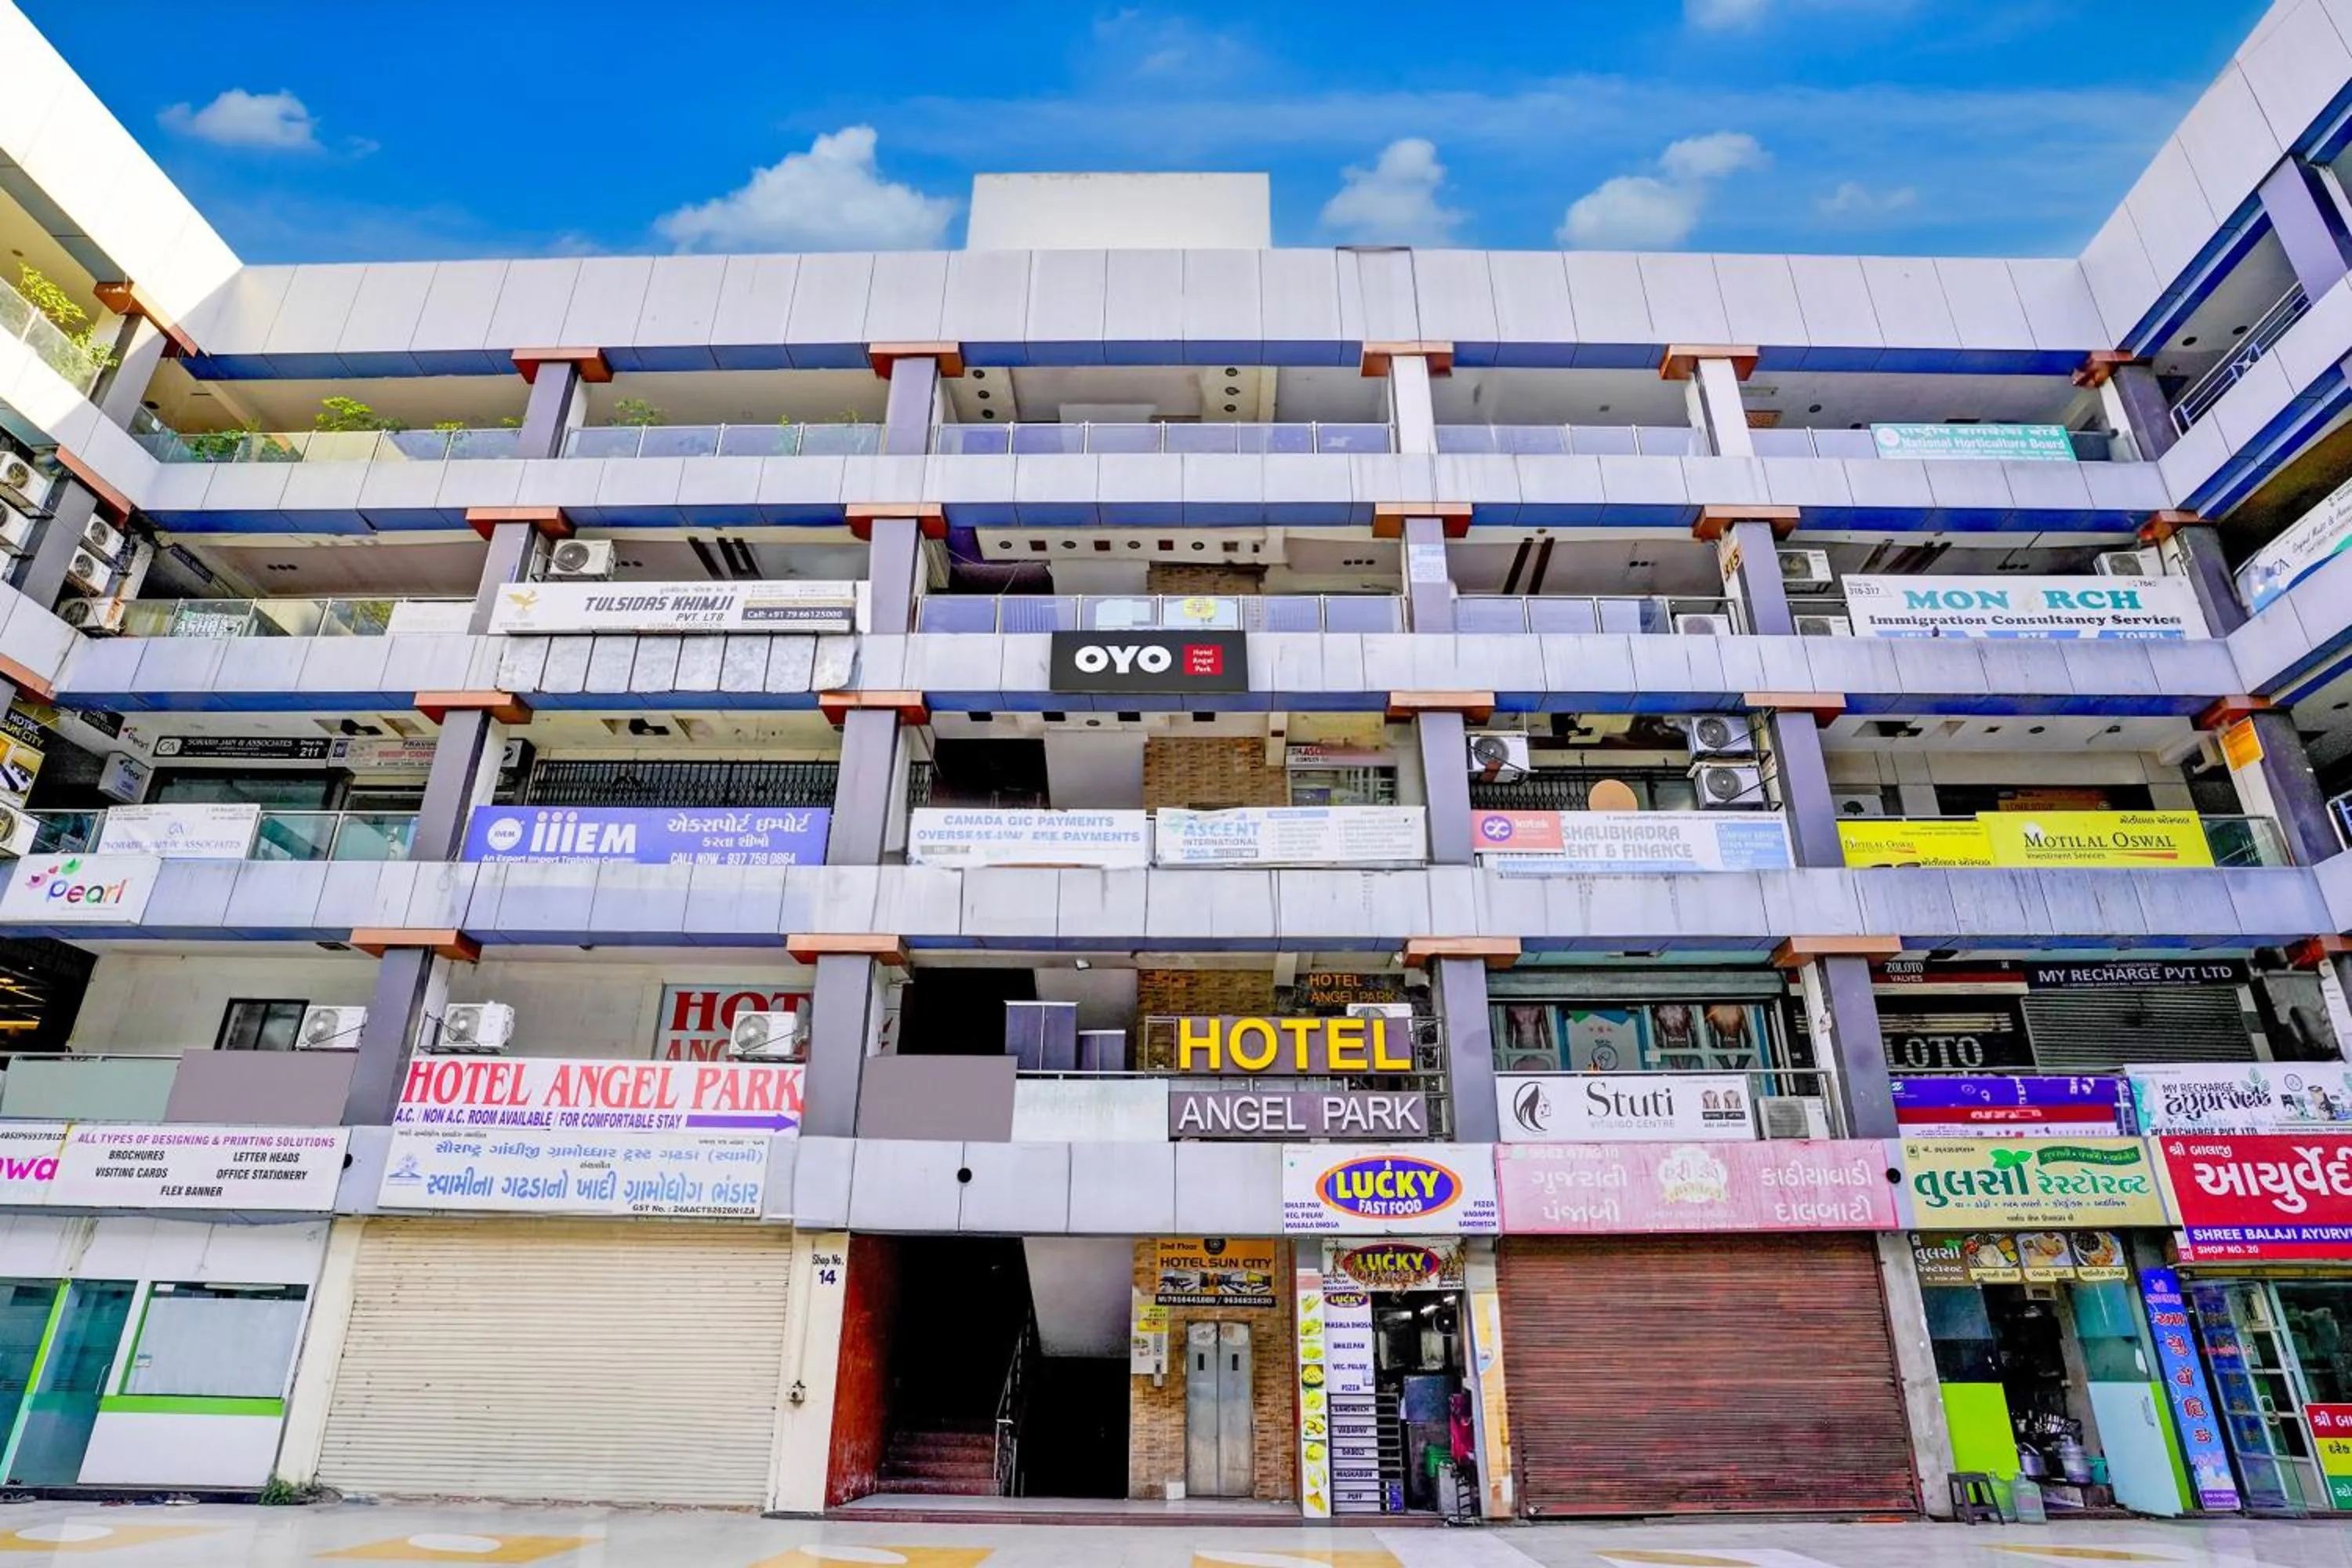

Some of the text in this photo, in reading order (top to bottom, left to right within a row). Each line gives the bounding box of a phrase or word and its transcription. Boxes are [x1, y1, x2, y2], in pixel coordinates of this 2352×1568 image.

[1901, 437, 2065, 450] National Horticulture Board
[584, 595, 735, 612] TULSIDAS KHIMJI
[1869, 615, 2182, 628] Immigration Consultancy Service
[1075, 645, 1172, 673] OYO
[1192, 657, 1214, 666] Angel
[299, 747, 318, 757] 211
[944, 815, 1003, 826] CANADA
[1038, 817, 1114, 827] PAYMENTS
[1184, 822, 1260, 837] ASCENT
[1563, 826, 1679, 840] SHALIBHADRA
[1064, 832, 1141, 842] PAYMENTS
[2024, 832, 2176, 848] MOTILAL OSWAL
[1623, 844, 1693, 858] FINANCE
[671, 853, 693, 864] CALL
[695, 853, 719, 864] NOW
[47, 879, 127, 902] pearl
[1885, 962, 1924, 973] ZOLOTO
[2038, 966, 2232, 982] MY RECHARGE PVT LTD
[1308, 975, 1362, 986] HOTEL
[1310, 991, 1395, 1003] ANGEL PARK
[1179, 1018, 1412, 1071] HOTEL
[1883, 1036, 1983, 1068] LOTO
[402, 1061, 804, 1112] HOTEL ANGEL PARK
[2180, 1083, 2234, 1092] RECHARGE
[1586, 1081, 1674, 1117] Stuti
[395, 1109, 682, 1129] A.C. NON A.C. ROOM AVAILABLE FOR COMFORTABLE STAY
[1178, 1096, 1421, 1132] ANGEL PARK
[78, 1135, 96, 1144] ALL
[100, 1135, 132, 1145] TYPES
[136, 1136, 149, 1145] OF
[152, 1136, 209, 1145] DESIGNING
[223, 1137, 272, 1146] PRINTING
[275, 1137, 335, 1147] SOLUTIONS
[108, 1151, 299, 1163] BROCHURES LETTER HEADS
[2169, 1142, 2232, 1158] શ્રી બાલાજી
[95, 1168, 307, 1181] VISITING CARDS OFFICE STATIONERY
[1532, 1164, 1627, 1194] ગુજરાતી
[160, 1186, 223, 1197] FLEX BANNER
[1337, 1171, 1439, 1199] LUCKY
[1914, 1162, 2030, 1208] તુલસી
[1358, 1200, 1422, 1214] FAST FOOD
[1543, 1198, 1619, 1222] પંજાબી
[1775, 1196, 1873, 1223] દાલબાટી
[2193, 1229, 2242, 1241] SHREE
[2245, 1229, 2296, 1242] BALAJI
[2247, 1245, 2259, 1254] 20
[812, 1254, 830, 1266] Shop
[1160, 1258, 1272, 1268] HOTEL SUN CITY
[1356, 1254, 1425, 1272] LUCKY
[819, 1269, 837, 1285] 14
[1330, 1294, 1363, 1303] LUCKY
[2314, 1410, 2332, 1426] શ્રી
